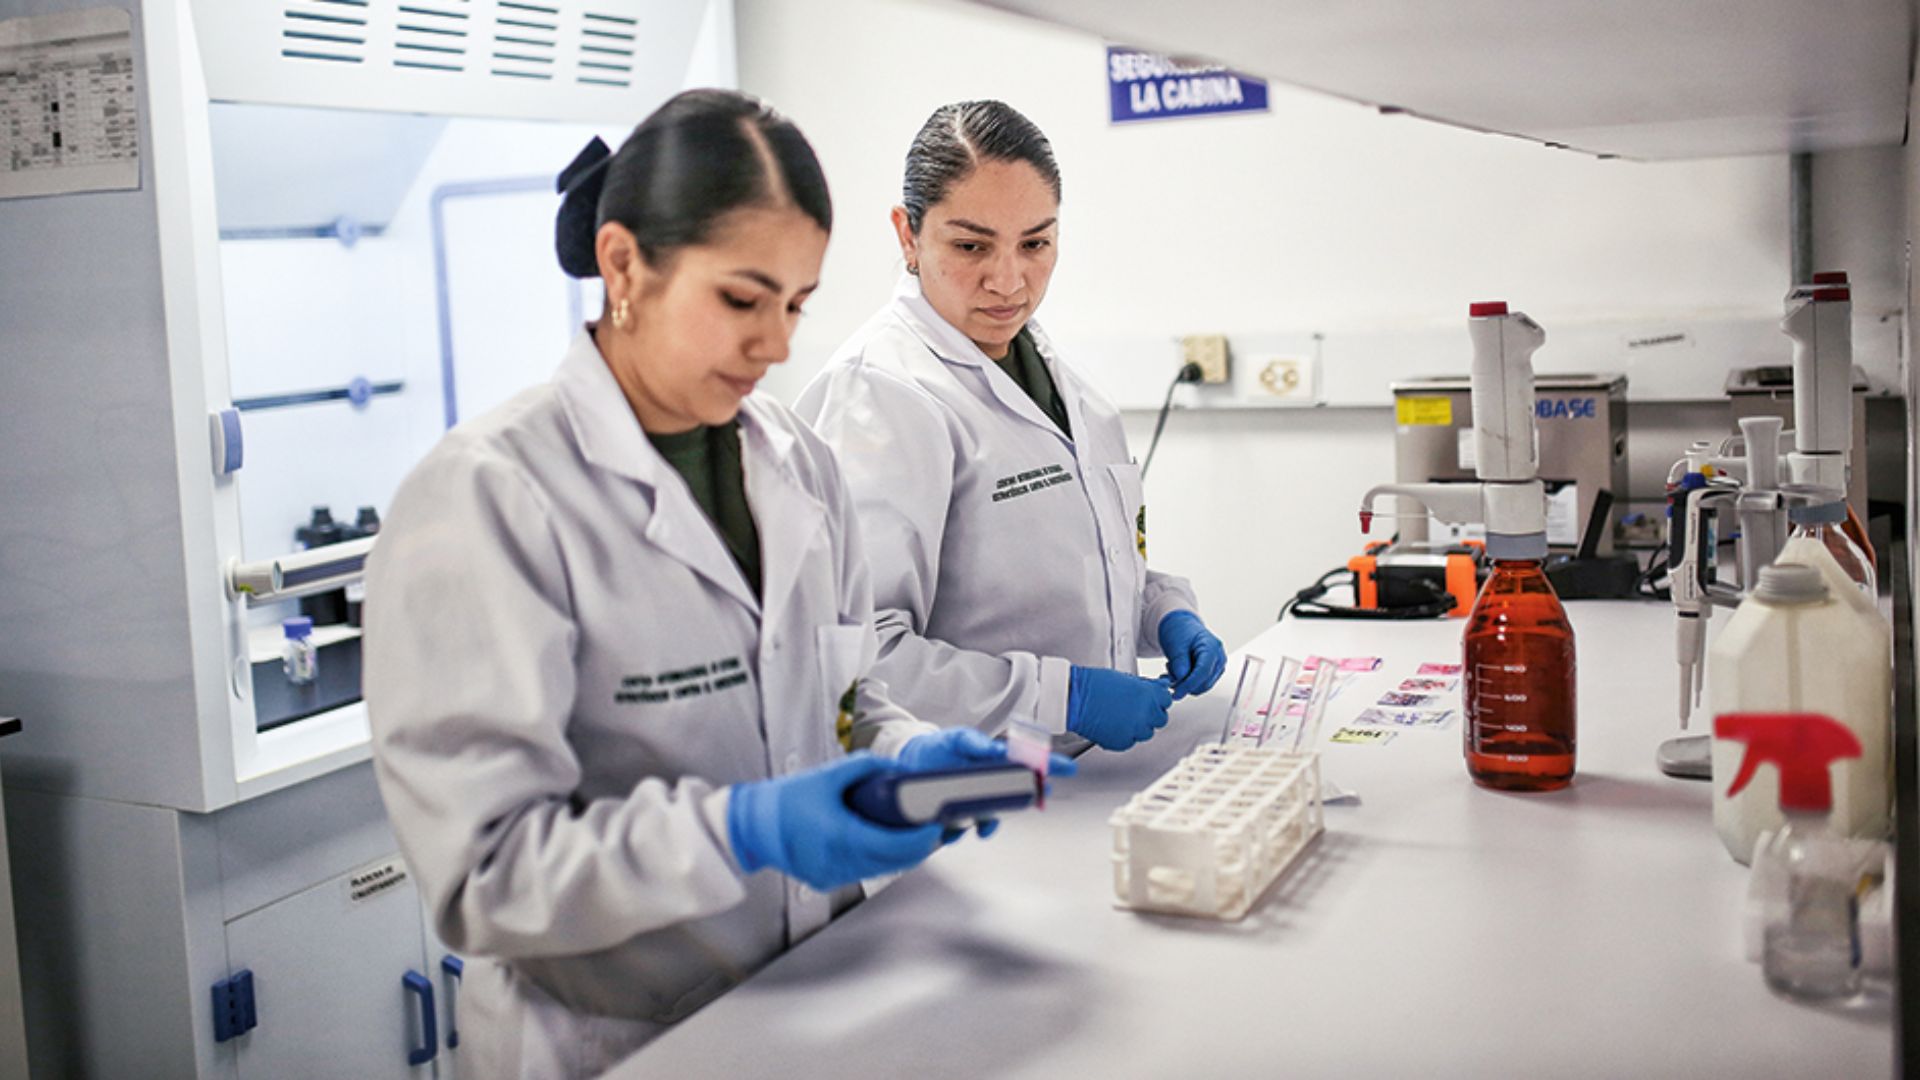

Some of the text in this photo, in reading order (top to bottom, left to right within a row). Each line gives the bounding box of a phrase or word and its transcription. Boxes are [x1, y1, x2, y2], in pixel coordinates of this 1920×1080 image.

[1130, 76, 1244, 113] LA CABINA
[1535, 398, 1596, 419] BASE
